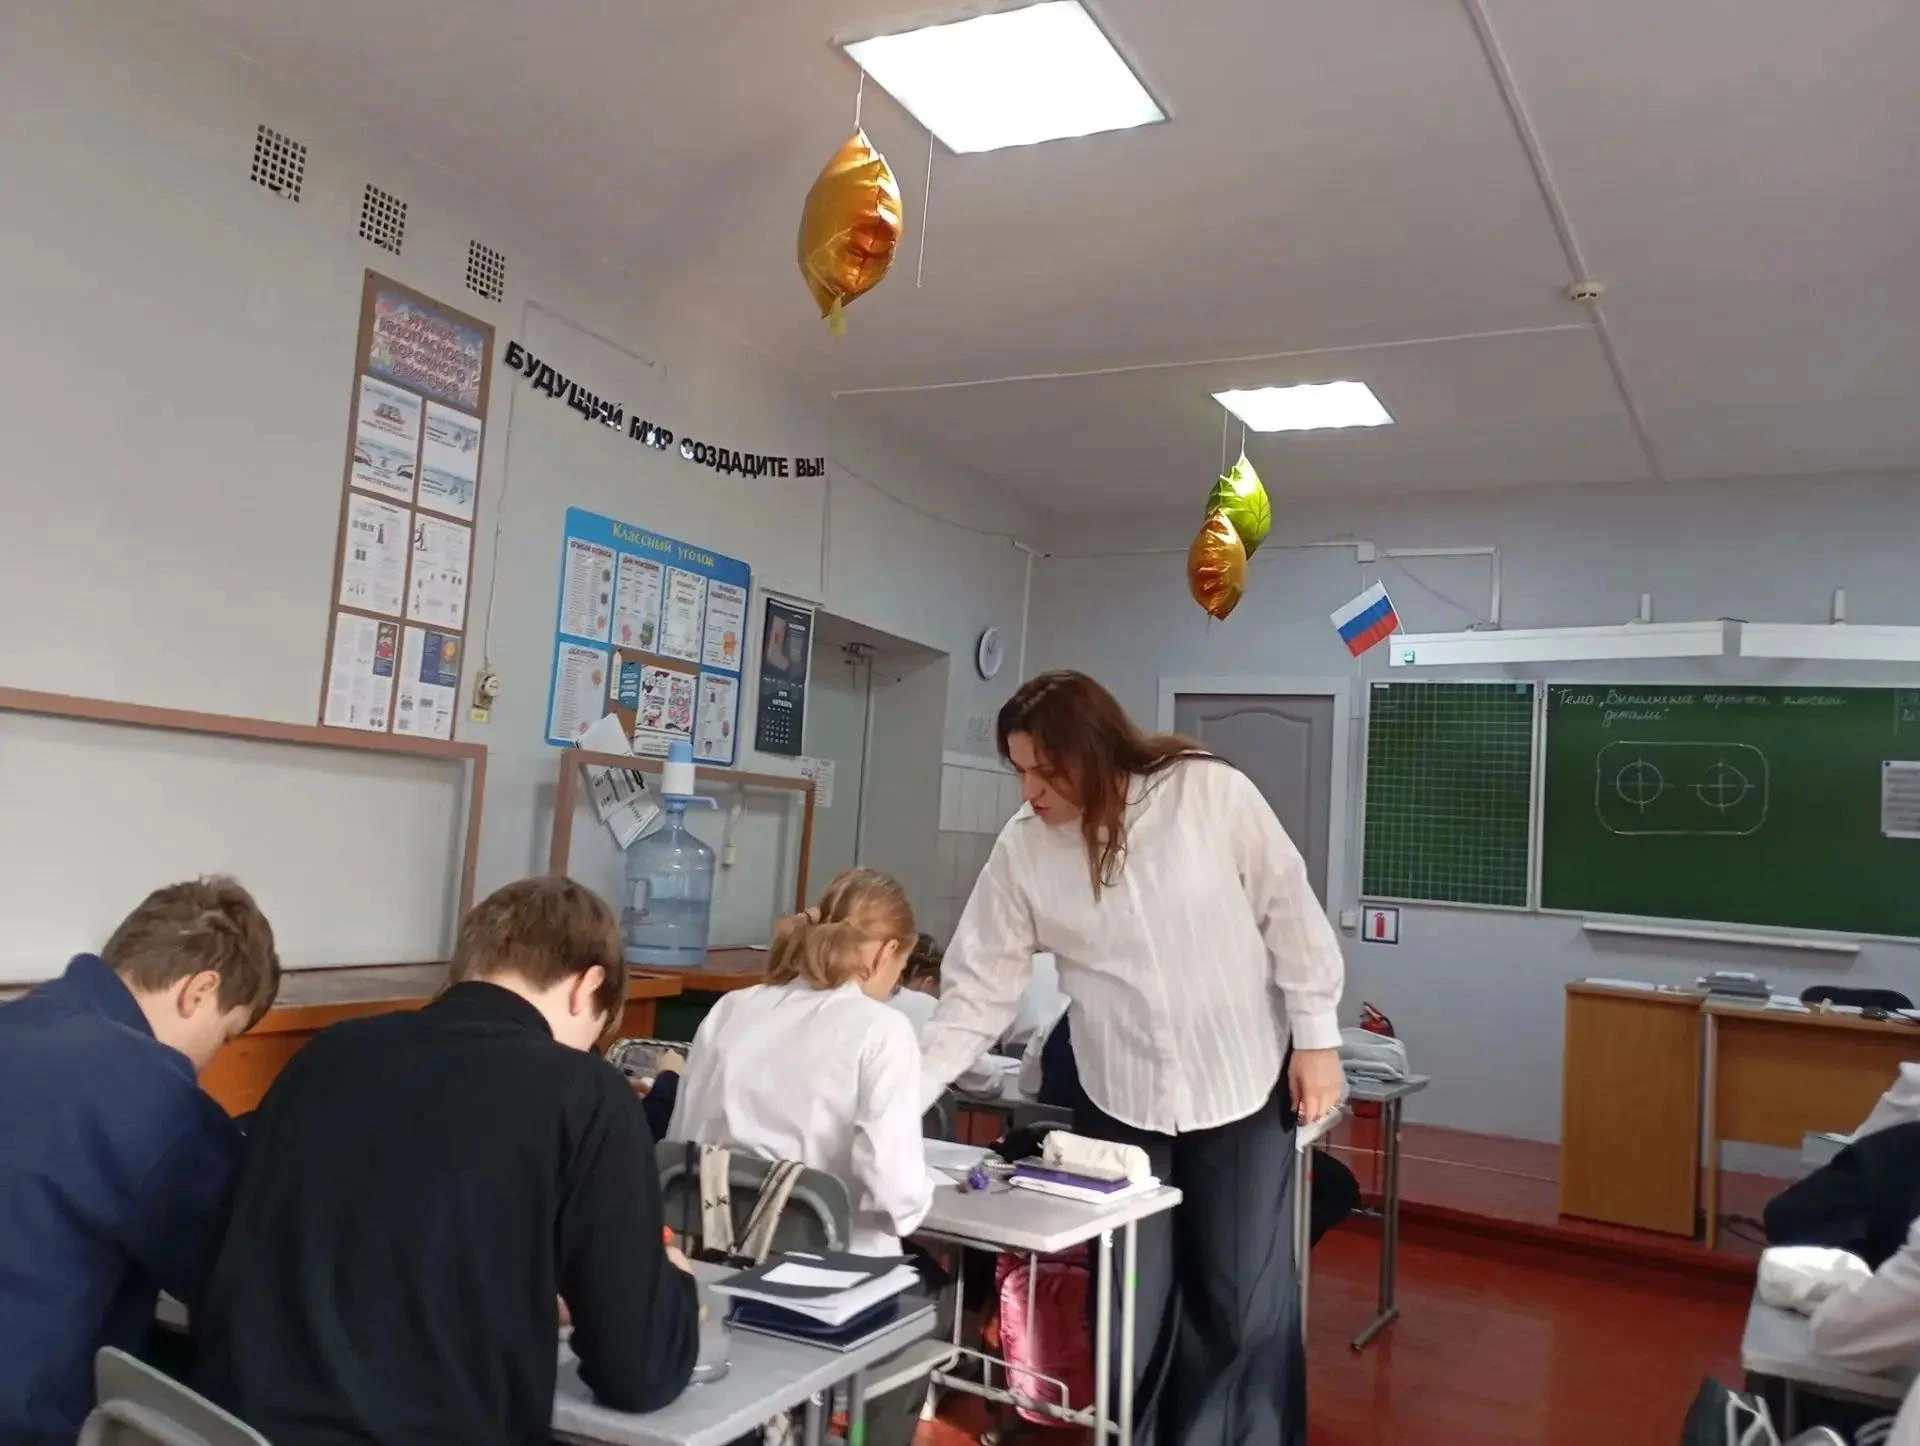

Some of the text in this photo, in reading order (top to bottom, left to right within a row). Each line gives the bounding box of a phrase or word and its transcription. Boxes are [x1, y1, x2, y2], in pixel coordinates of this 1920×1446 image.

[504, 340, 624, 431] БУДУЩИЙ
[629, 416, 674, 452] МИР
[680, 438, 789, 479] СОЗДАДИТЕ
[795, 457, 826, 478] ВЫ!
[612, 522, 716, 569] Классный уголок
